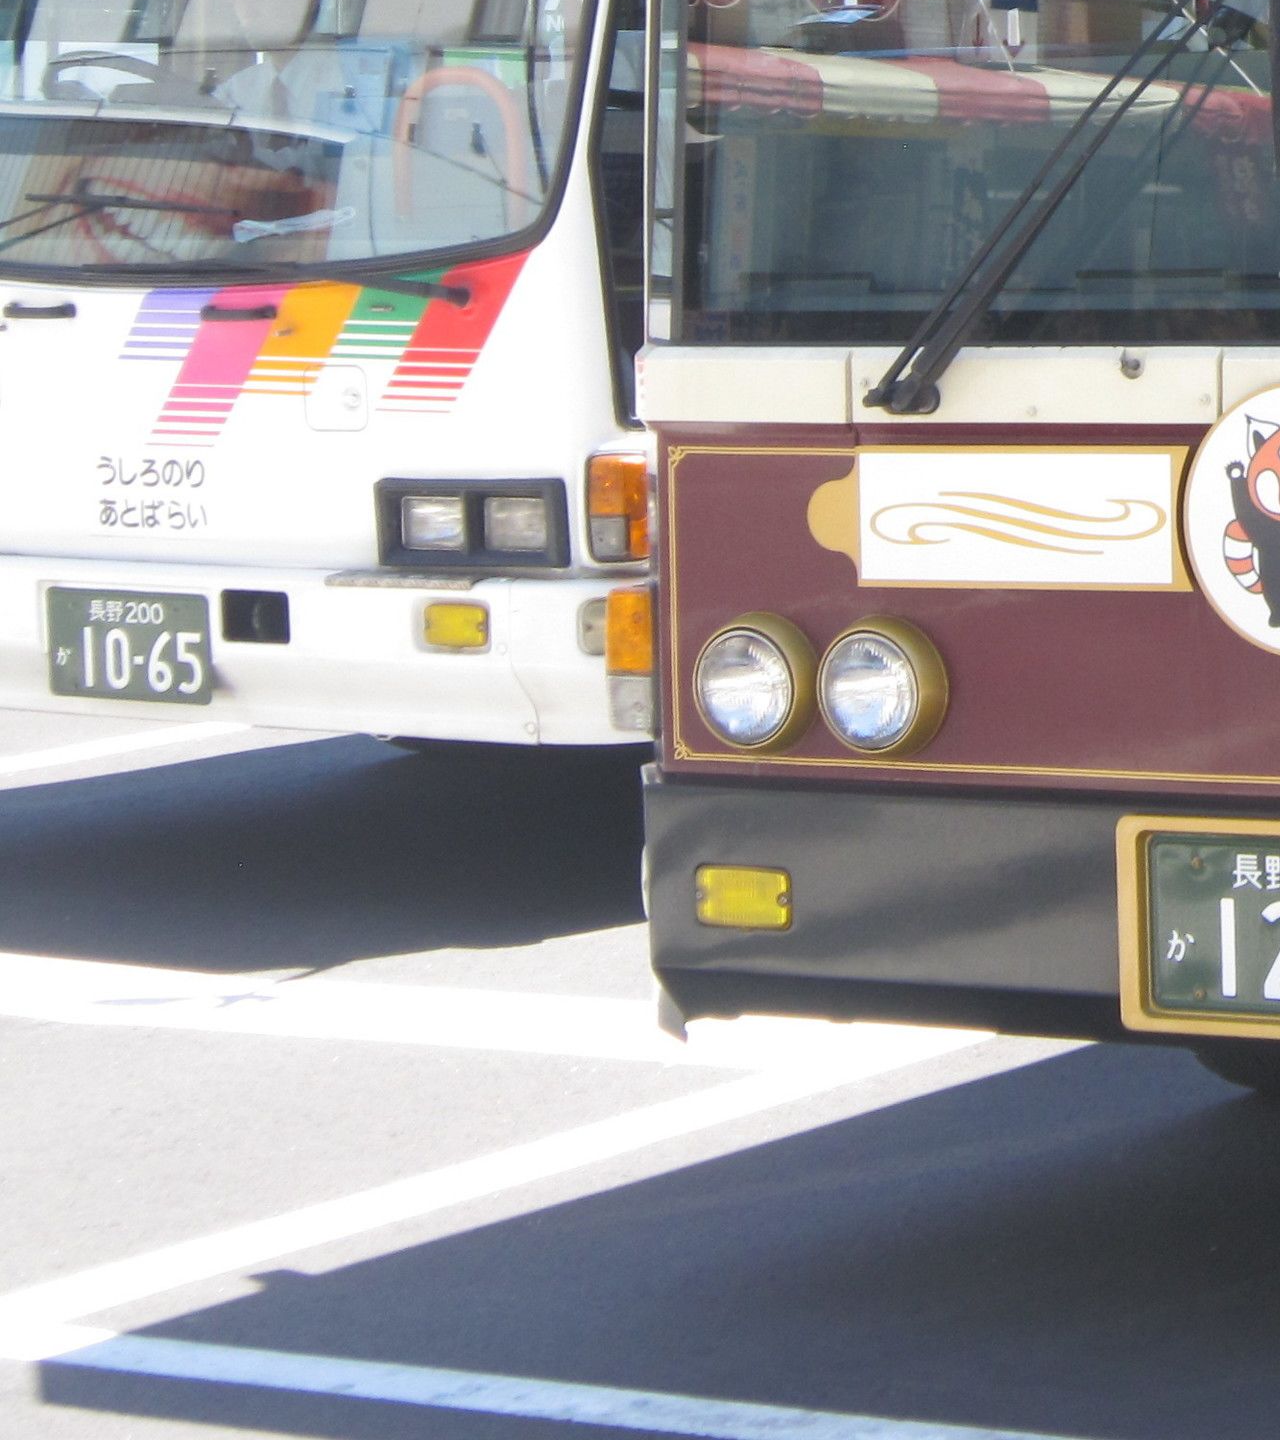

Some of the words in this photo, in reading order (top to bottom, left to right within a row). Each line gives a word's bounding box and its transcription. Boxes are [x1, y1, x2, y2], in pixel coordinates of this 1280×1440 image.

[96, 456, 206, 488] うしろのり
[99, 498, 209, 530] あとばらい
[80, 626, 204, 695] 10-65
[1166, 929, 1195, 962] か
